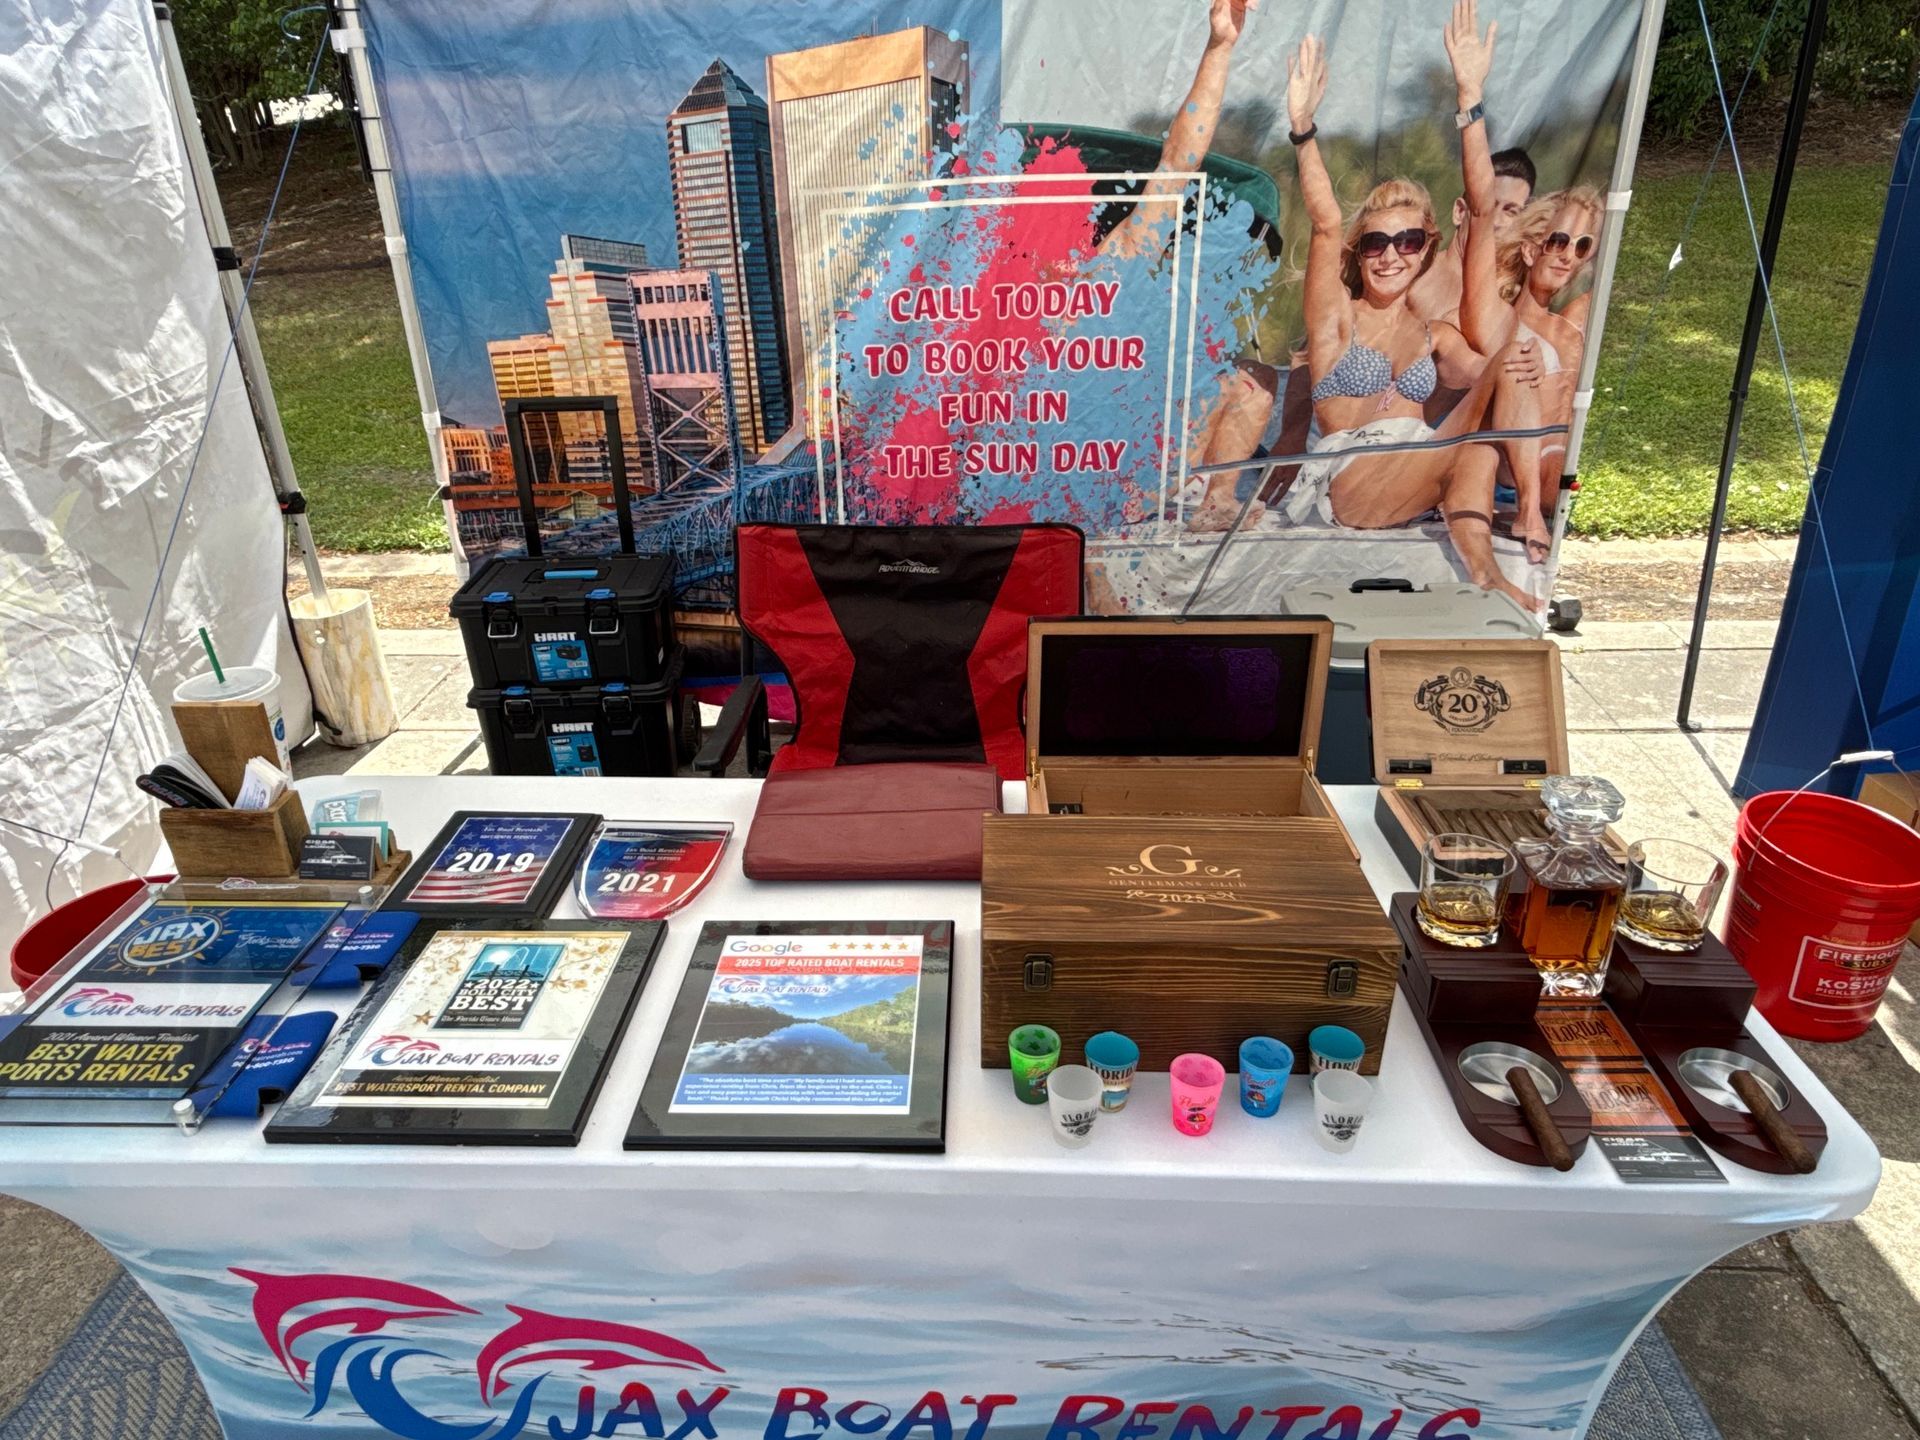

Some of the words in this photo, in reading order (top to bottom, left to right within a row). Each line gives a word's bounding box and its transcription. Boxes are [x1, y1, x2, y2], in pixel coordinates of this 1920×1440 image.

[889, 285, 981, 323] CALL
[992, 281, 1122, 319] TODAY
[864, 343, 910, 378] TO
[923, 338, 1028, 375] BOOK
[1040, 336, 1145, 372] YOUR
[938, 392, 1013, 427] FUN
[1027, 390, 1068, 423] IN
[883, 445, 952, 479] THE
[963, 442, 1039, 476] SUN
[1053, 440, 1127, 473] DAY
[533, 631, 577, 643] HART
[551, 722, 594, 733] HART
[446, 852, 535, 873] 2019
[1139, 844, 1204, 876] G
[597, 872, 676, 893] 2021
[1158, 893, 1206, 903] 2025
[133, 921, 214, 946] JAX
[730, 940, 803, 955] Google
[734, 958, 762, 967] 2025
[764, 958, 786, 967] TOP
[787, 958, 823, 967] RATED
[824, 958, 854, 967] BOAT
[855, 958, 905, 967] RENTALS
[457, 988, 499, 996] BOLD
[500, 989, 538, 997] CITY
[473, 978, 531, 990] 2022
[169, 1004, 247, 1017] RENTALS
[448, 995, 534, 1011] BEST
[25, 1043, 98, 1061] BEST
[94, 1043, 184, 1061] WATER
[400, 1052, 440, 1065] JAX
[436, 1052, 484, 1065] BOAT
[483, 1053, 561, 1066] RENTALS
[0, 1062, 82, 1081] PORTS
[77, 1063, 196, 1082] RENTALS
[366, 1082, 443, 1092] WATERSPORT
[442, 1083, 486, 1092] RENTAL
[488, 1084, 548, 1093] COMPANY
[548, 1382, 730, 1440] JAX
[763, 1387, 1018, 1440] BOAT
